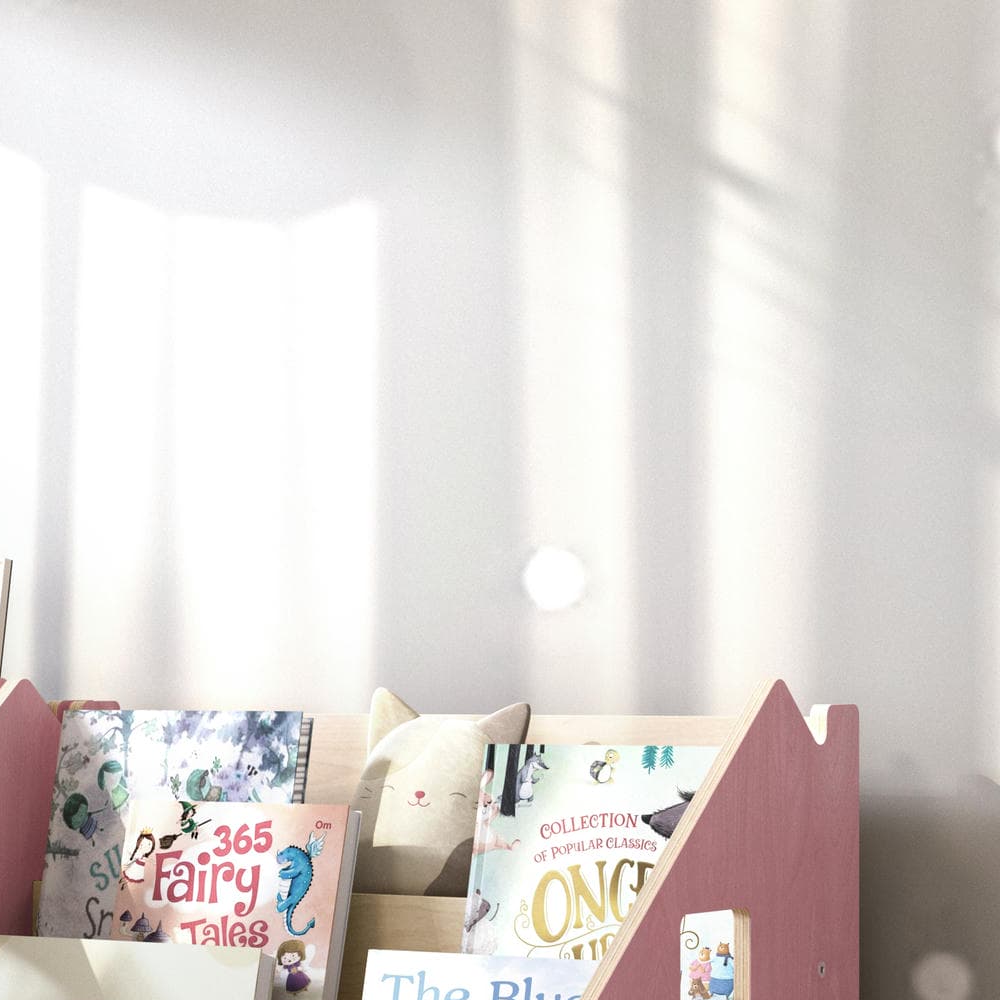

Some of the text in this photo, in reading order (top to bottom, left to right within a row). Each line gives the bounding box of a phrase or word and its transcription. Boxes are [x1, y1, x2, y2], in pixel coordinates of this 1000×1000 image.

[212, 820, 273, 857] 365
[315, 820, 332, 830] Om
[540, 812, 639, 840] COLLECTION
[534, 836, 657, 863] OF POPULAR CLASSICS
[152, 850, 260, 917] Fairy
[180, 915, 269, 948] Tales
